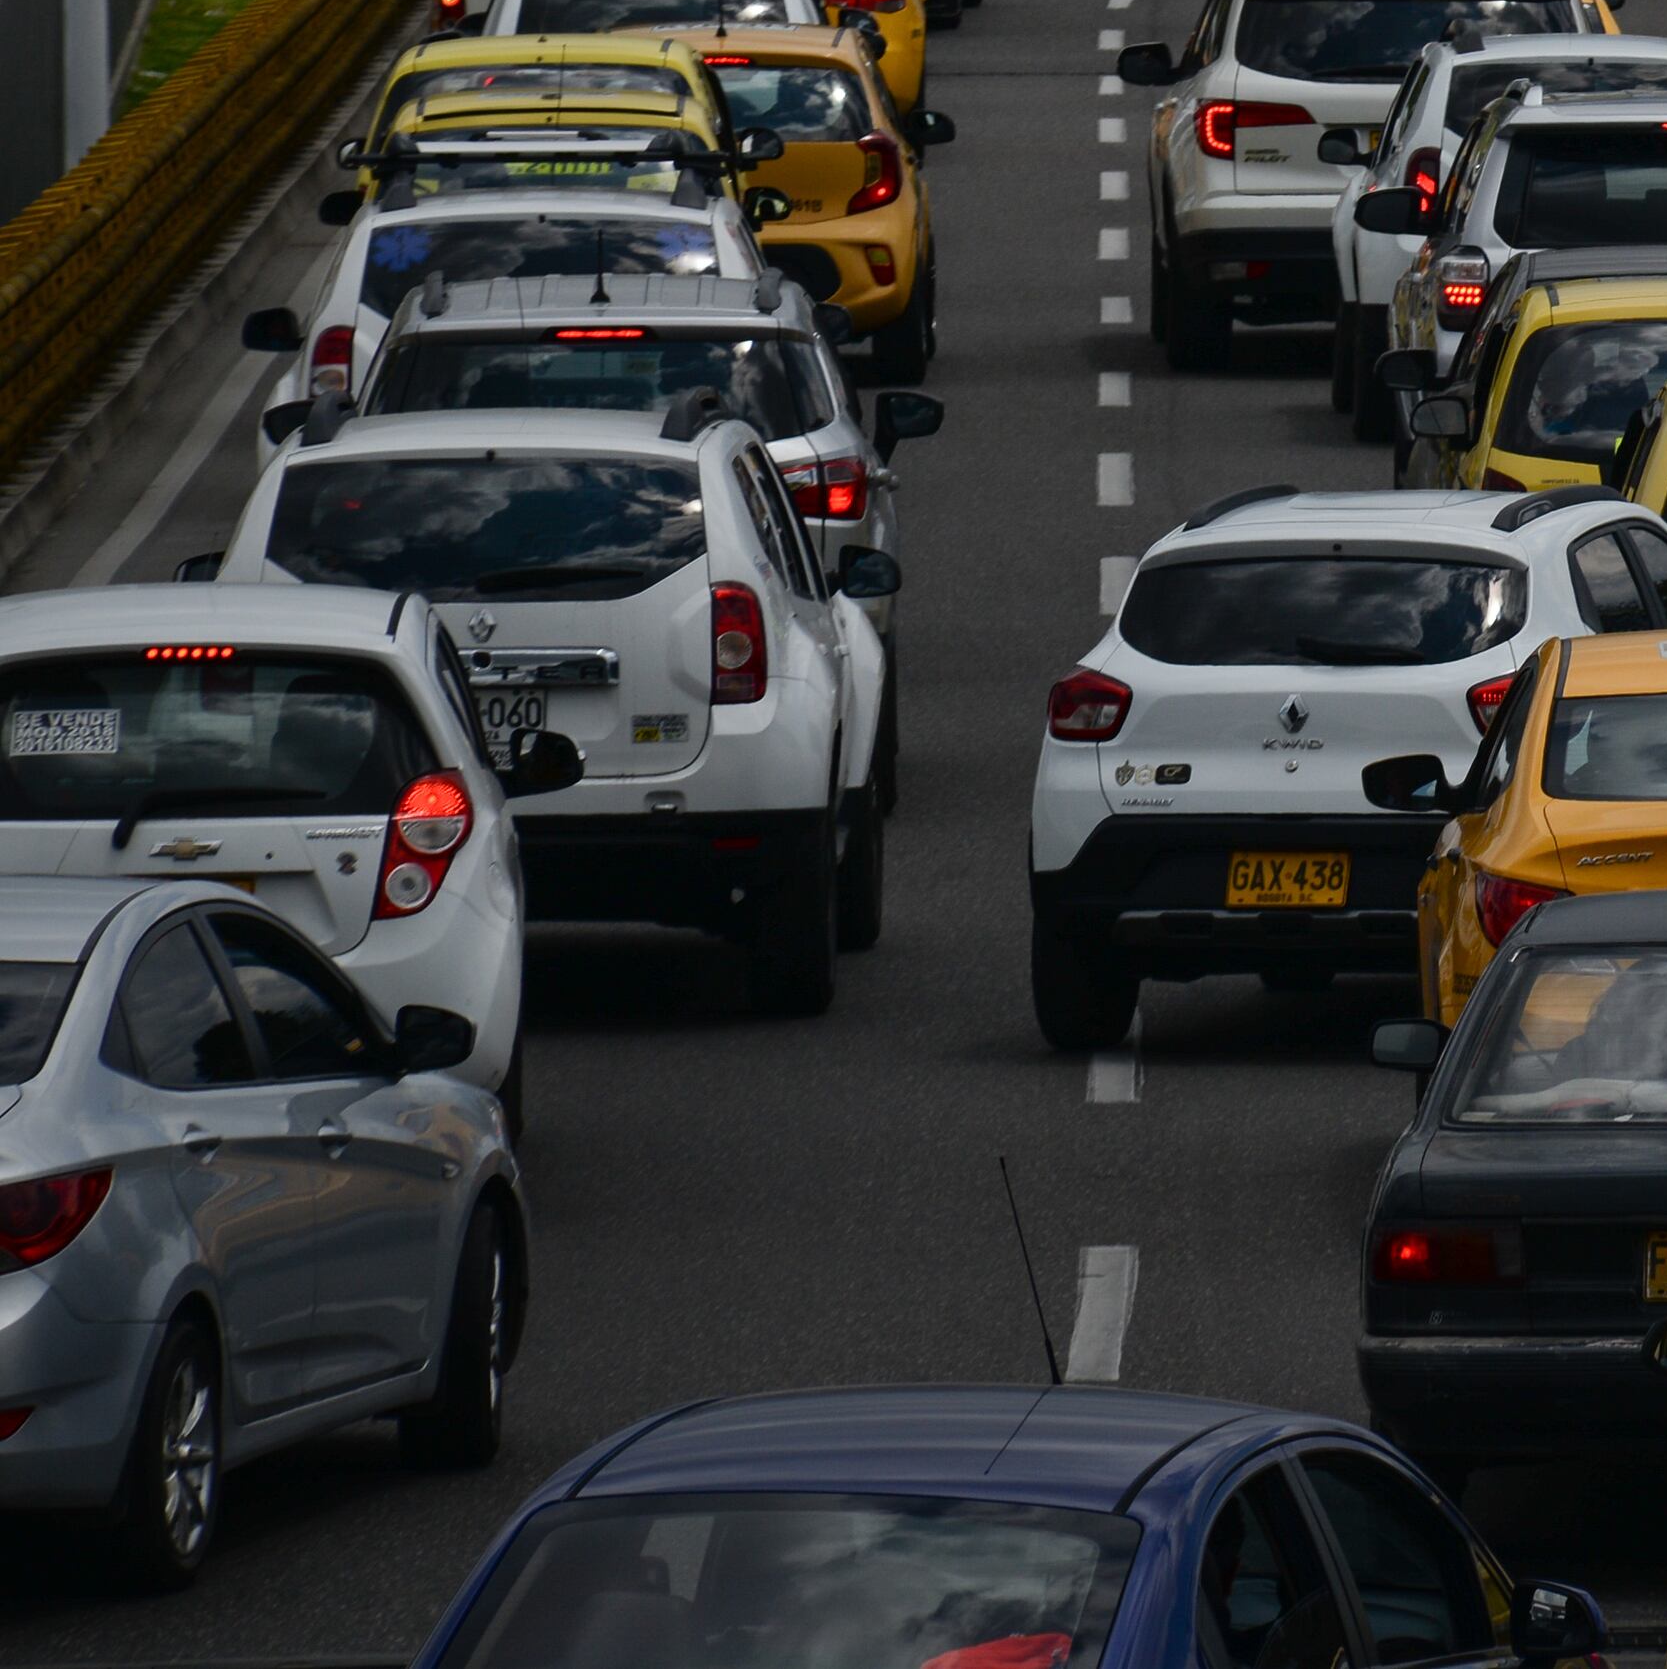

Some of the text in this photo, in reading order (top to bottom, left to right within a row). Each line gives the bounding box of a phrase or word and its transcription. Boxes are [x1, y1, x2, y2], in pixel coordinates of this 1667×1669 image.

[48, 711, 116, 727] VENDE
[1263, 737, 1325, 751] KWID
[1120, 797, 1175, 807] RENAULT
[1576, 851, 1655, 868] ACCENT
[1232, 858, 1347, 894] GAX 438
